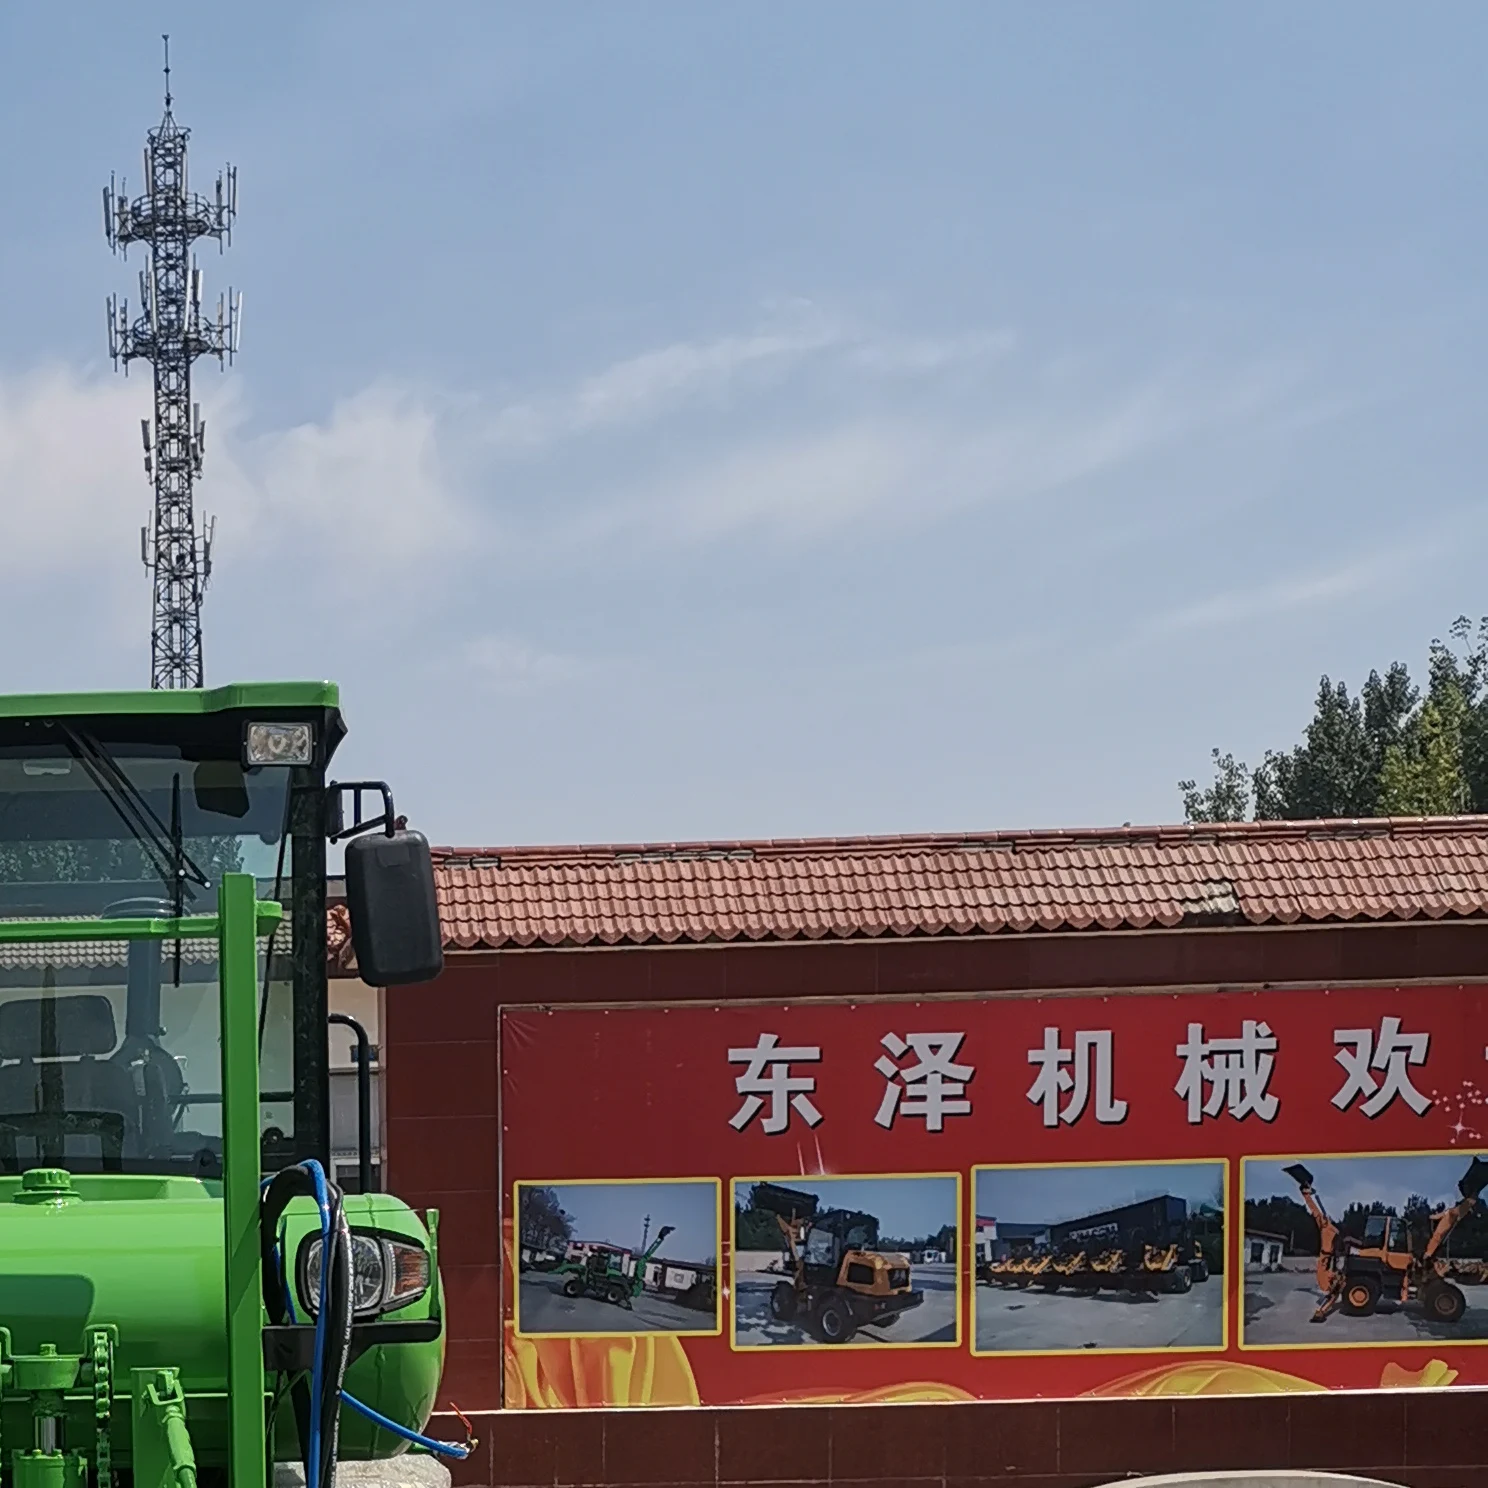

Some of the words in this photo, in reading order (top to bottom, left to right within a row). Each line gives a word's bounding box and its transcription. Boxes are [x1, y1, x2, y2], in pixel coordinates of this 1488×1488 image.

[727, 1016, 1488, 1133] 东泽机械欢
